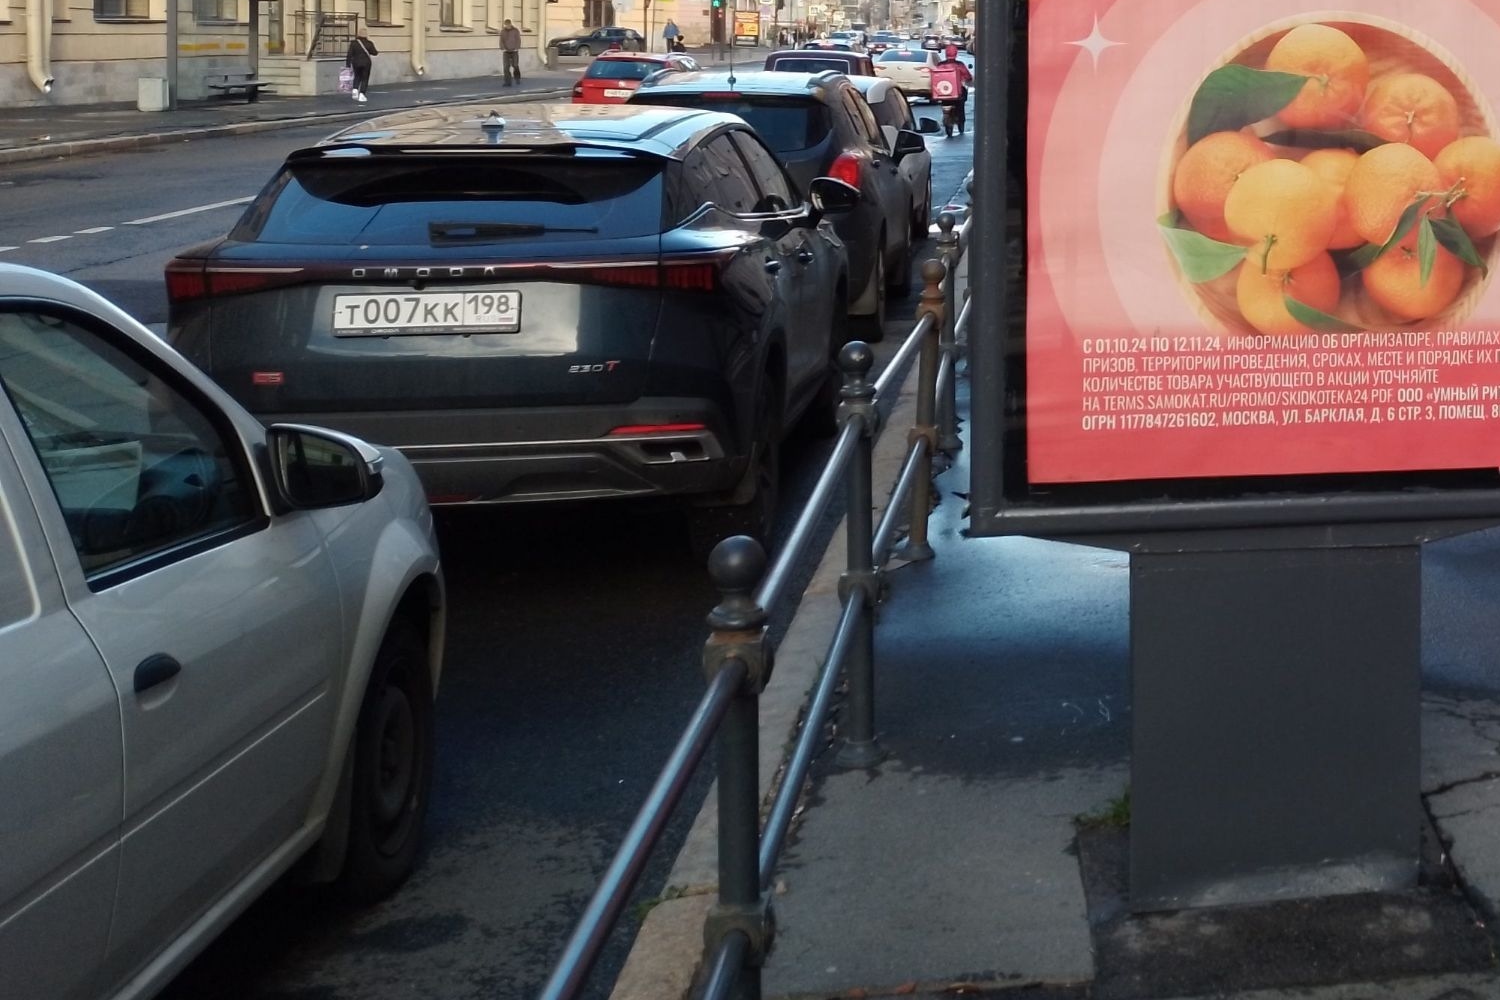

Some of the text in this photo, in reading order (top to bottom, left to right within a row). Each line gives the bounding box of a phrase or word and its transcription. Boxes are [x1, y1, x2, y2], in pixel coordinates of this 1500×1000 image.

[345, 294, 510, 325] Т007КК 198
[1083, 338, 1093, 353] С
[1095, 338, 1147, 354] 01.10.24
[1150, 337, 1169, 353] ПО
[1227, 334, 1319, 351] ИНФОРМАЦИЮ
[1322, 334, 1338, 348] ОБ
[1341, 331, 1434, 348] ОРГАНИЗАТОРЕ,
[1142, 355, 1220, 372] ТЕРРИТОРИИ
[1223, 353, 1310, 370] ПРОВЕДЕНИЯ,
[1367, 350, 1403, 366] МЕСТЕ
[1406, 350, 1415, 365] И
[1417, 349, 1474, 366] ПОРЯДКЕ
[1476, 348, 1493, 364] ИХ
[1083, 366, 1439, 392] КОЛИЧЕСТВЕ ТОВАРА УЧАСТВУЮЩЕГО В АКЦИИ УТОЧНЯЙТЕ
[1082, 396, 1100, 412] НА
[1397, 387, 1423, 403] ООО
[1426, 384, 1479, 403] «УМНЫЙ
[1082, 415, 1116, 430] ОГРН
[1222, 410, 1279, 426] МОСКВА,
[1282, 409, 1302, 425] УЛ.
[1305, 408, 1367, 424] БАРКЛАЯ,
[1387, 407, 1396, 421] 6
